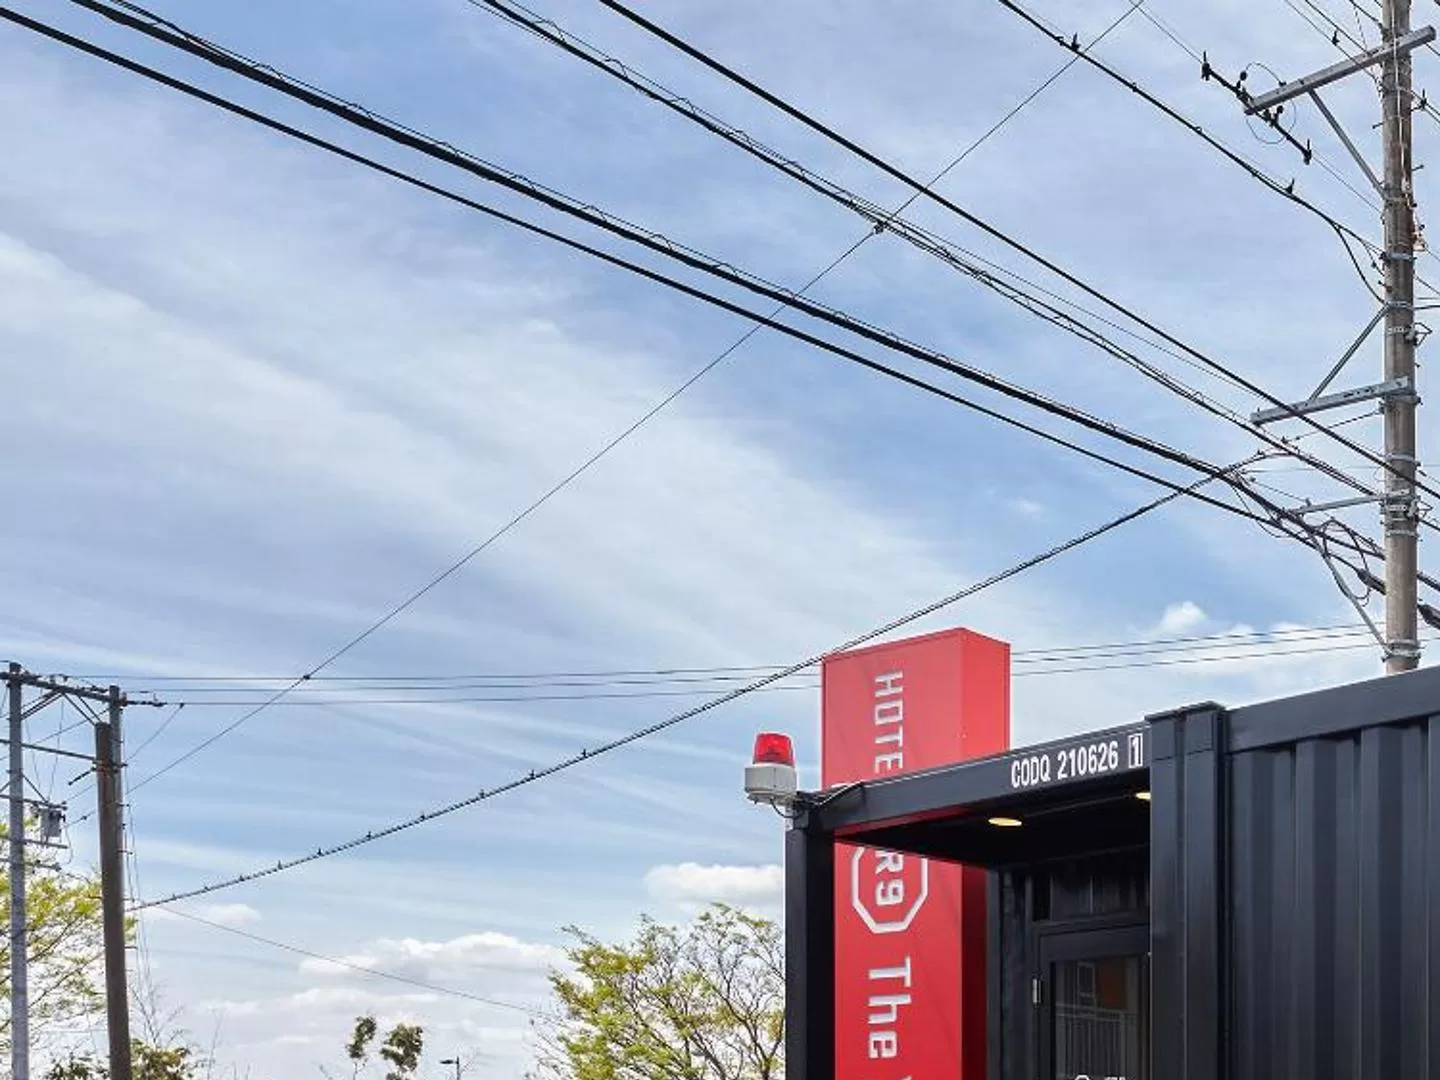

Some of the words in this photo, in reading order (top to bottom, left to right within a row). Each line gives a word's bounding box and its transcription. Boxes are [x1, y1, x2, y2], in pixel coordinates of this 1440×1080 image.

[874, 671, 904, 774] HOTE
[1011, 754, 1051, 788] CODQ
[1057, 740, 1119, 781] 210626
[1130, 734, 1142, 768] 1
[874, 849, 905, 906] R9
[867, 956, 912, 1059] The
